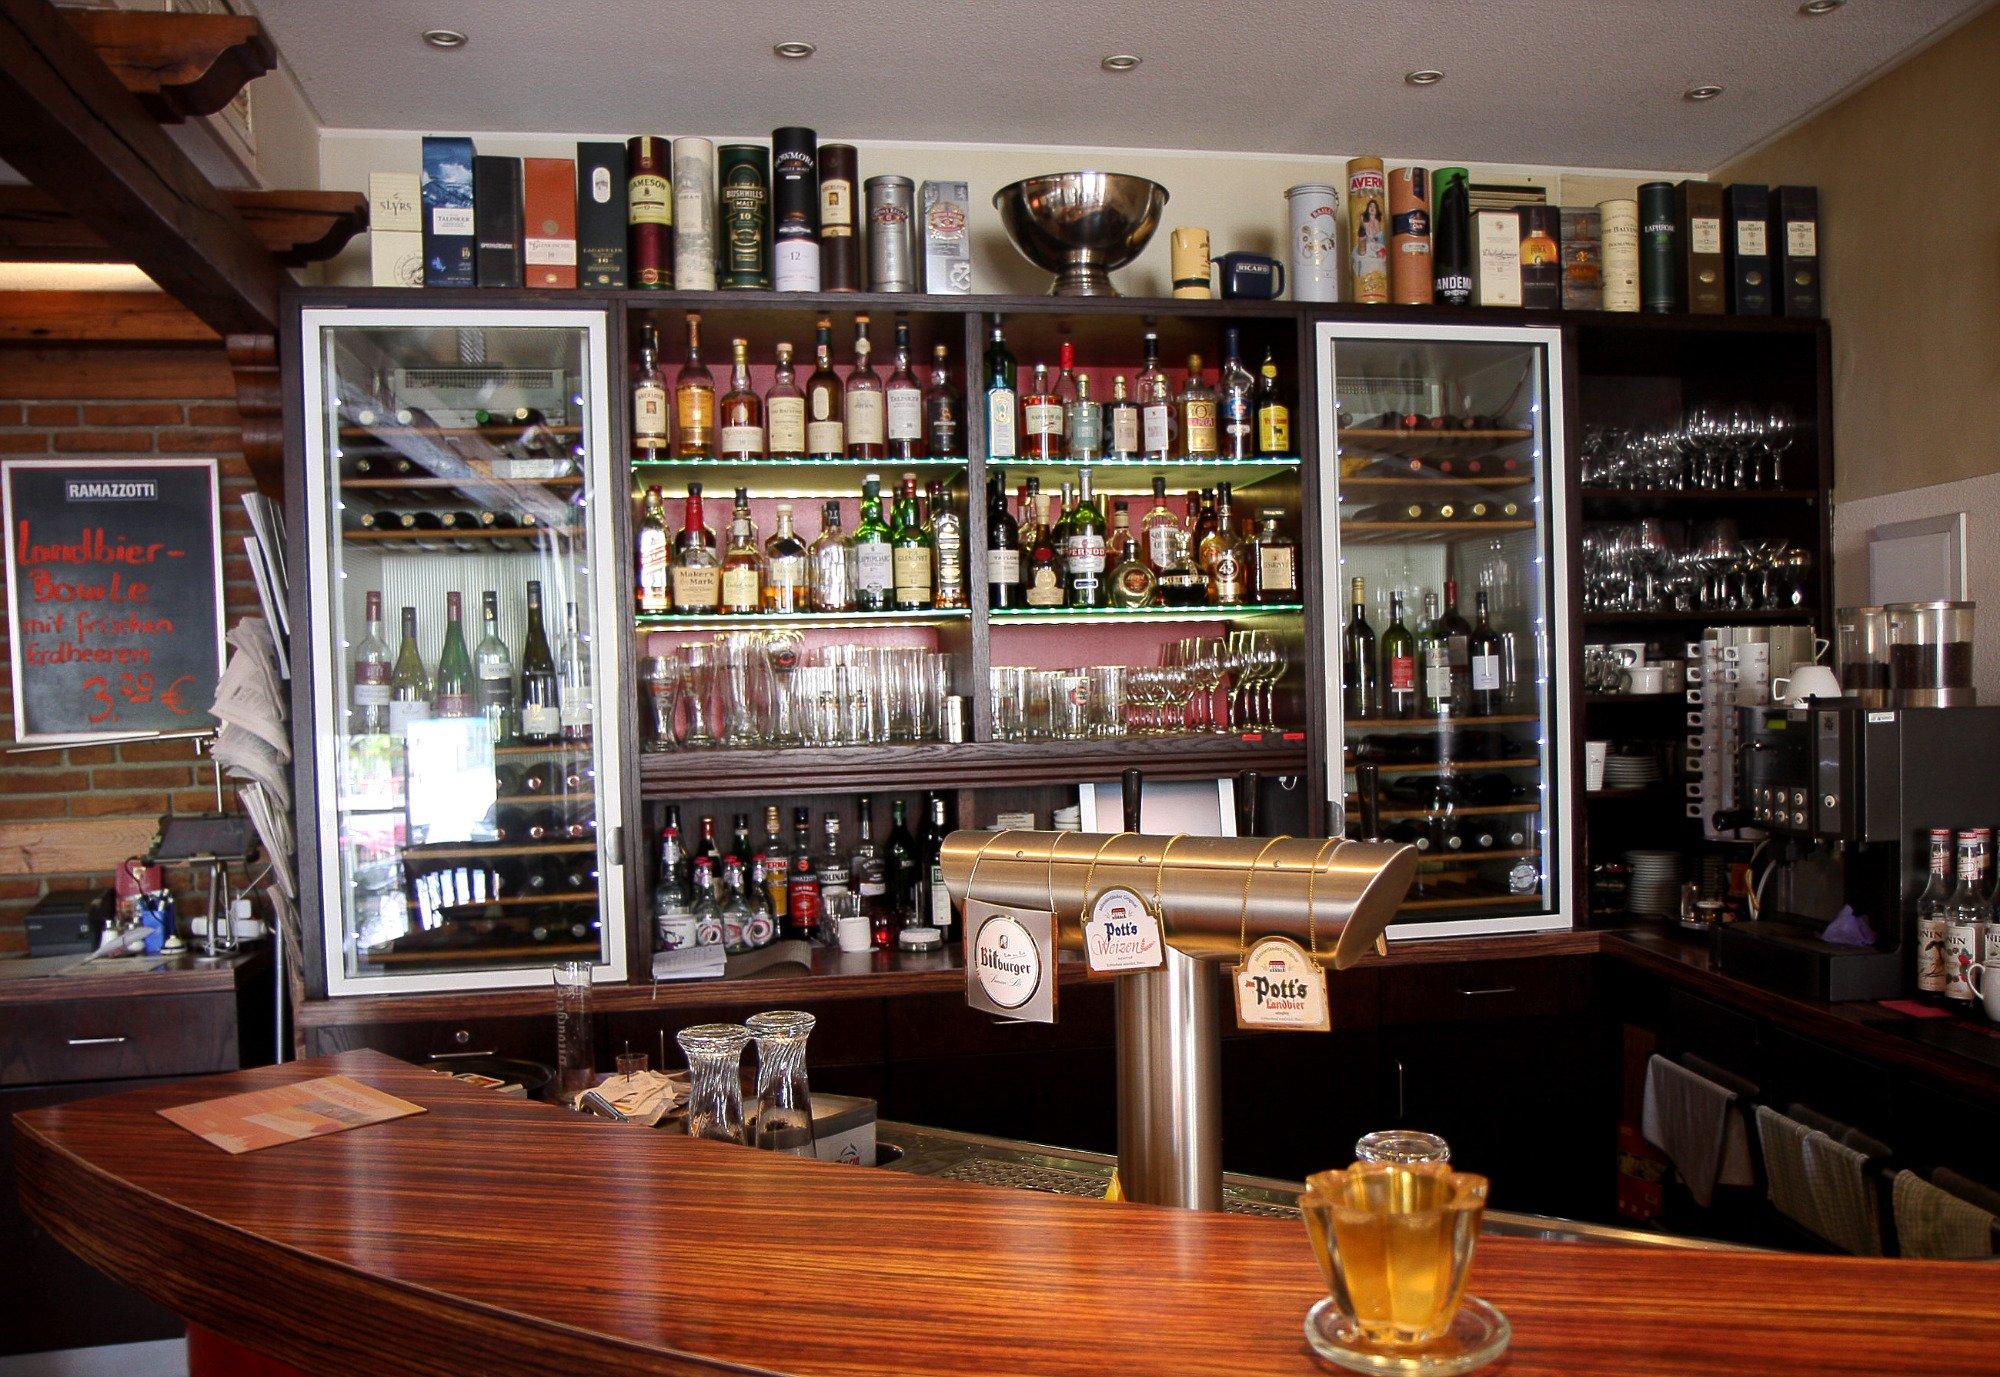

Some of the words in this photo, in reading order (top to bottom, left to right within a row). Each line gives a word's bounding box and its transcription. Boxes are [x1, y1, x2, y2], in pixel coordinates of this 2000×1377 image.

[1351, 176, 1384, 190] AVERN
[726, 188, 764, 200] BUSHMILLS
[739, 212, 751, 221] 10
[789, 252, 801, 261] 12
[69, 482, 155, 498] RAMAZZOTTI
[1069, 546, 1105, 556] PERNOD
[680, 571, 715, 579] Maker's
[690, 577, 714, 585] Mark
[22, 611, 65, 634] mit
[1104, 921, 1139, 943] Pott's
[1091, 933, 1145, 956] Weizen
[980, 946, 1031, 976] Bitburger
[1252, 975, 1309, 1005] Pott's
[1266, 998, 1305, 1010] Landbier
